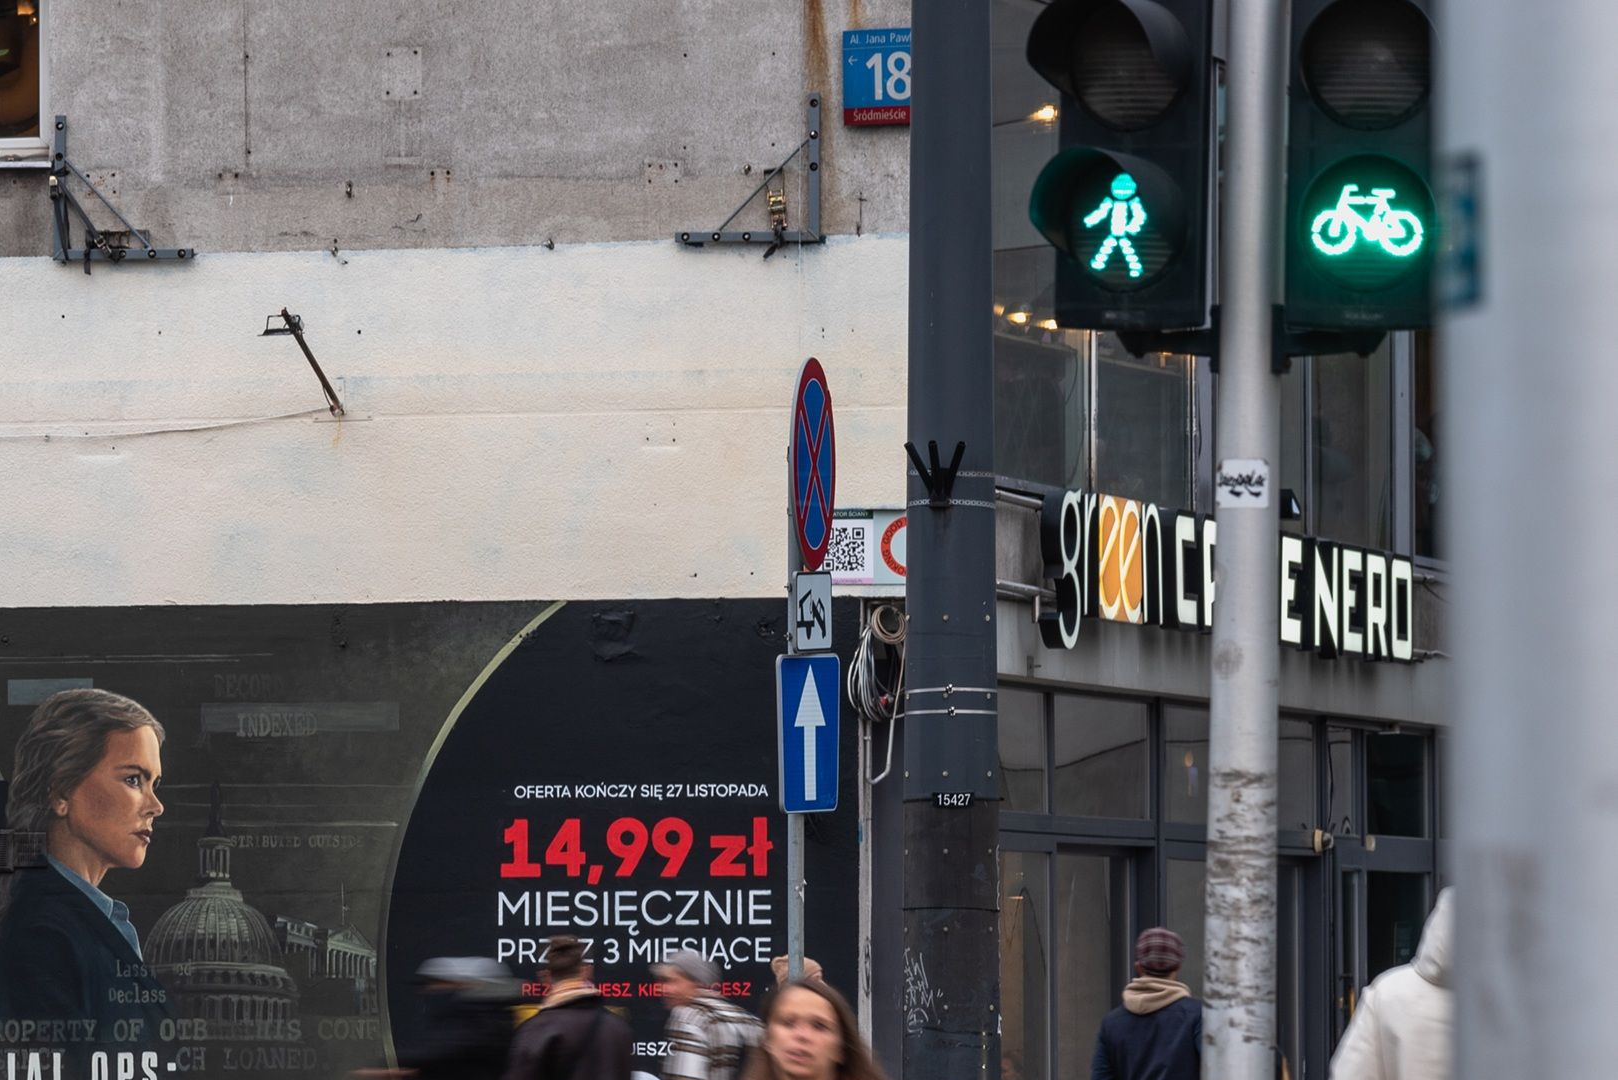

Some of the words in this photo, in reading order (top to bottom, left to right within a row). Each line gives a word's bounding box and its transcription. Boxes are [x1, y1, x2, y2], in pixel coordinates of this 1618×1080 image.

[865, 34, 886, 45] Jana
[865, 51, 911, 101] 18
[853, 108, 907, 122] Śródmieście
[1059, 488, 1163, 650] green
[1314, 544, 1413, 661] NERO
[236, 712, 318, 738] INDEXED
[514, 785, 572, 799] OFERTA
[575, 782, 635, 799] KOŃCZY
[640, 784, 664, 801] SIĘ
[666, 784, 684, 798] 27
[686, 784, 769, 798] LISTOPADA
[936, 793, 972, 807] 15427
[500, 816, 694, 885] 14,99
[709, 816, 774, 877] zł
[497, 889, 772, 936] MIESIĘCZNIE
[497, 938, 595, 964] PRZZ
[602, 938, 621, 964] 3
[113, 1018, 145, 1042] OF
